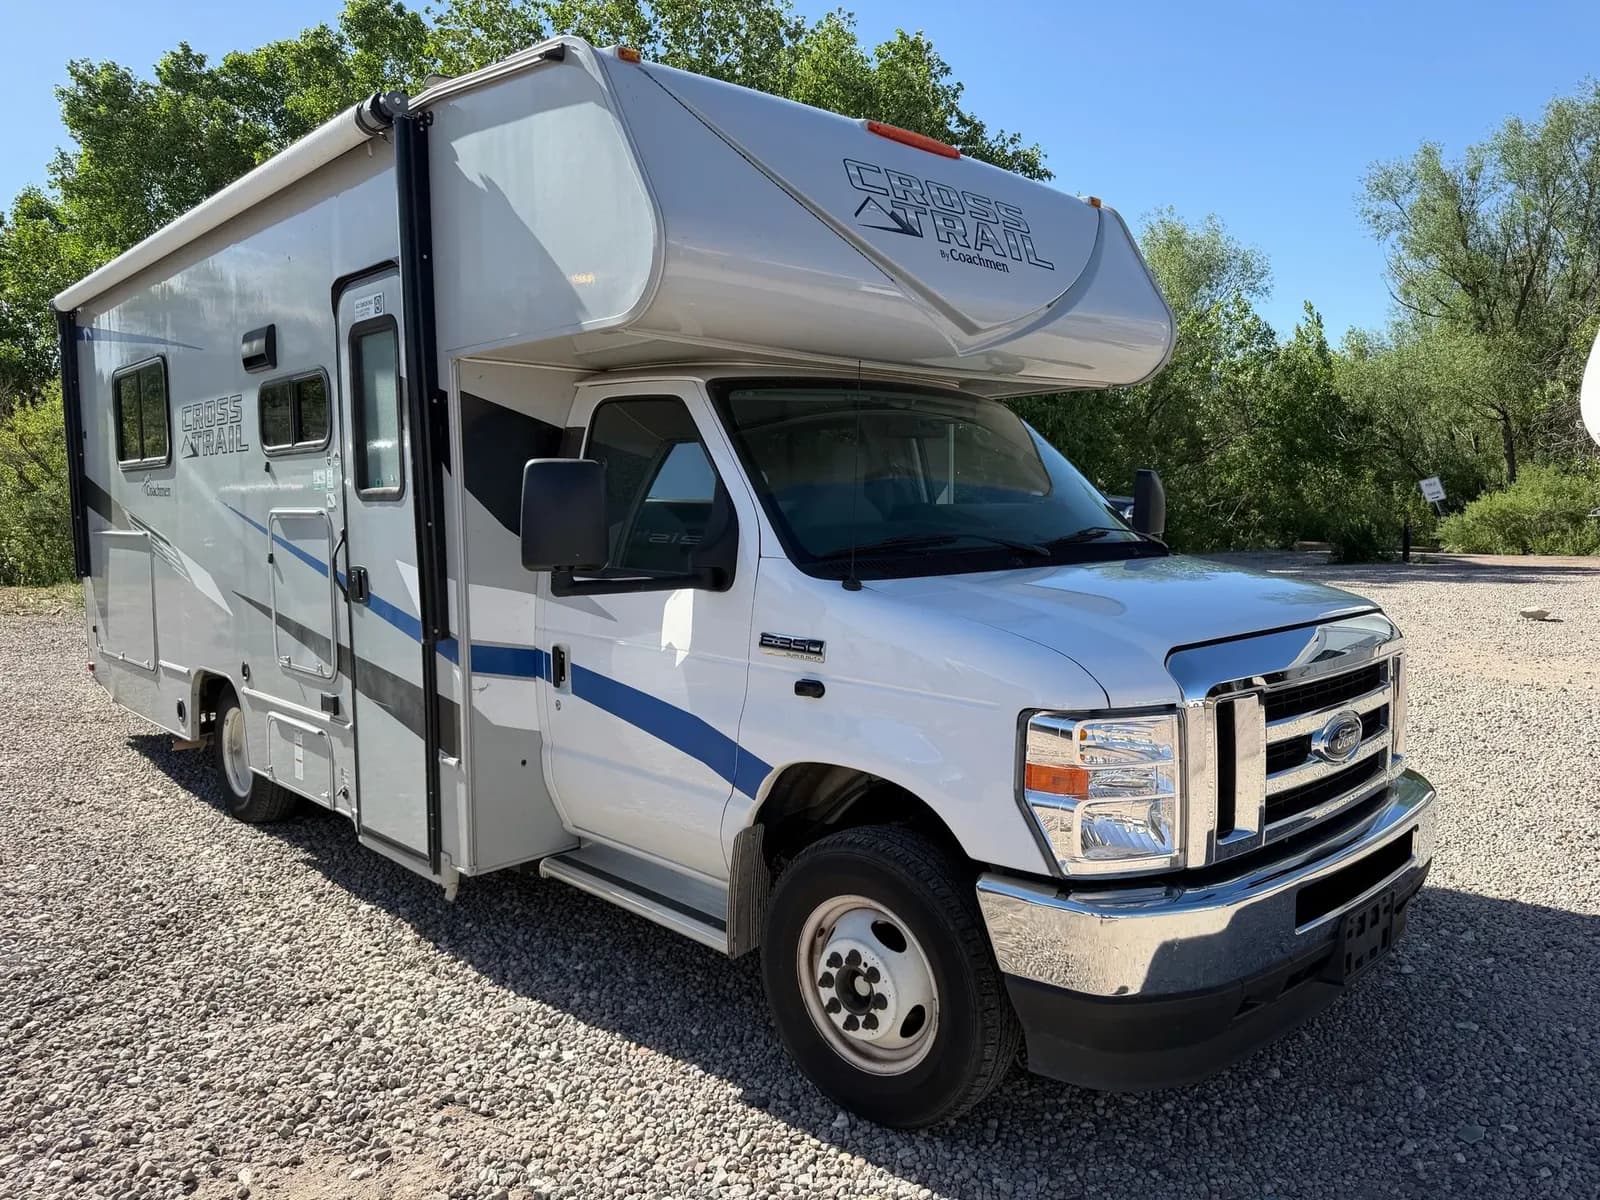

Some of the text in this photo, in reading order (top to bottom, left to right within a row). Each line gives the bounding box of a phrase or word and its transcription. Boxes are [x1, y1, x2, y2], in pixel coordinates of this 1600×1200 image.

[843, 158, 1030, 233] CROSS
[891, 200, 1055, 270] TRAIL
[940, 248, 1010, 273] By Coachmen
[182, 394, 242, 432] CROSS
[192, 425, 249, 457] TRAIL
